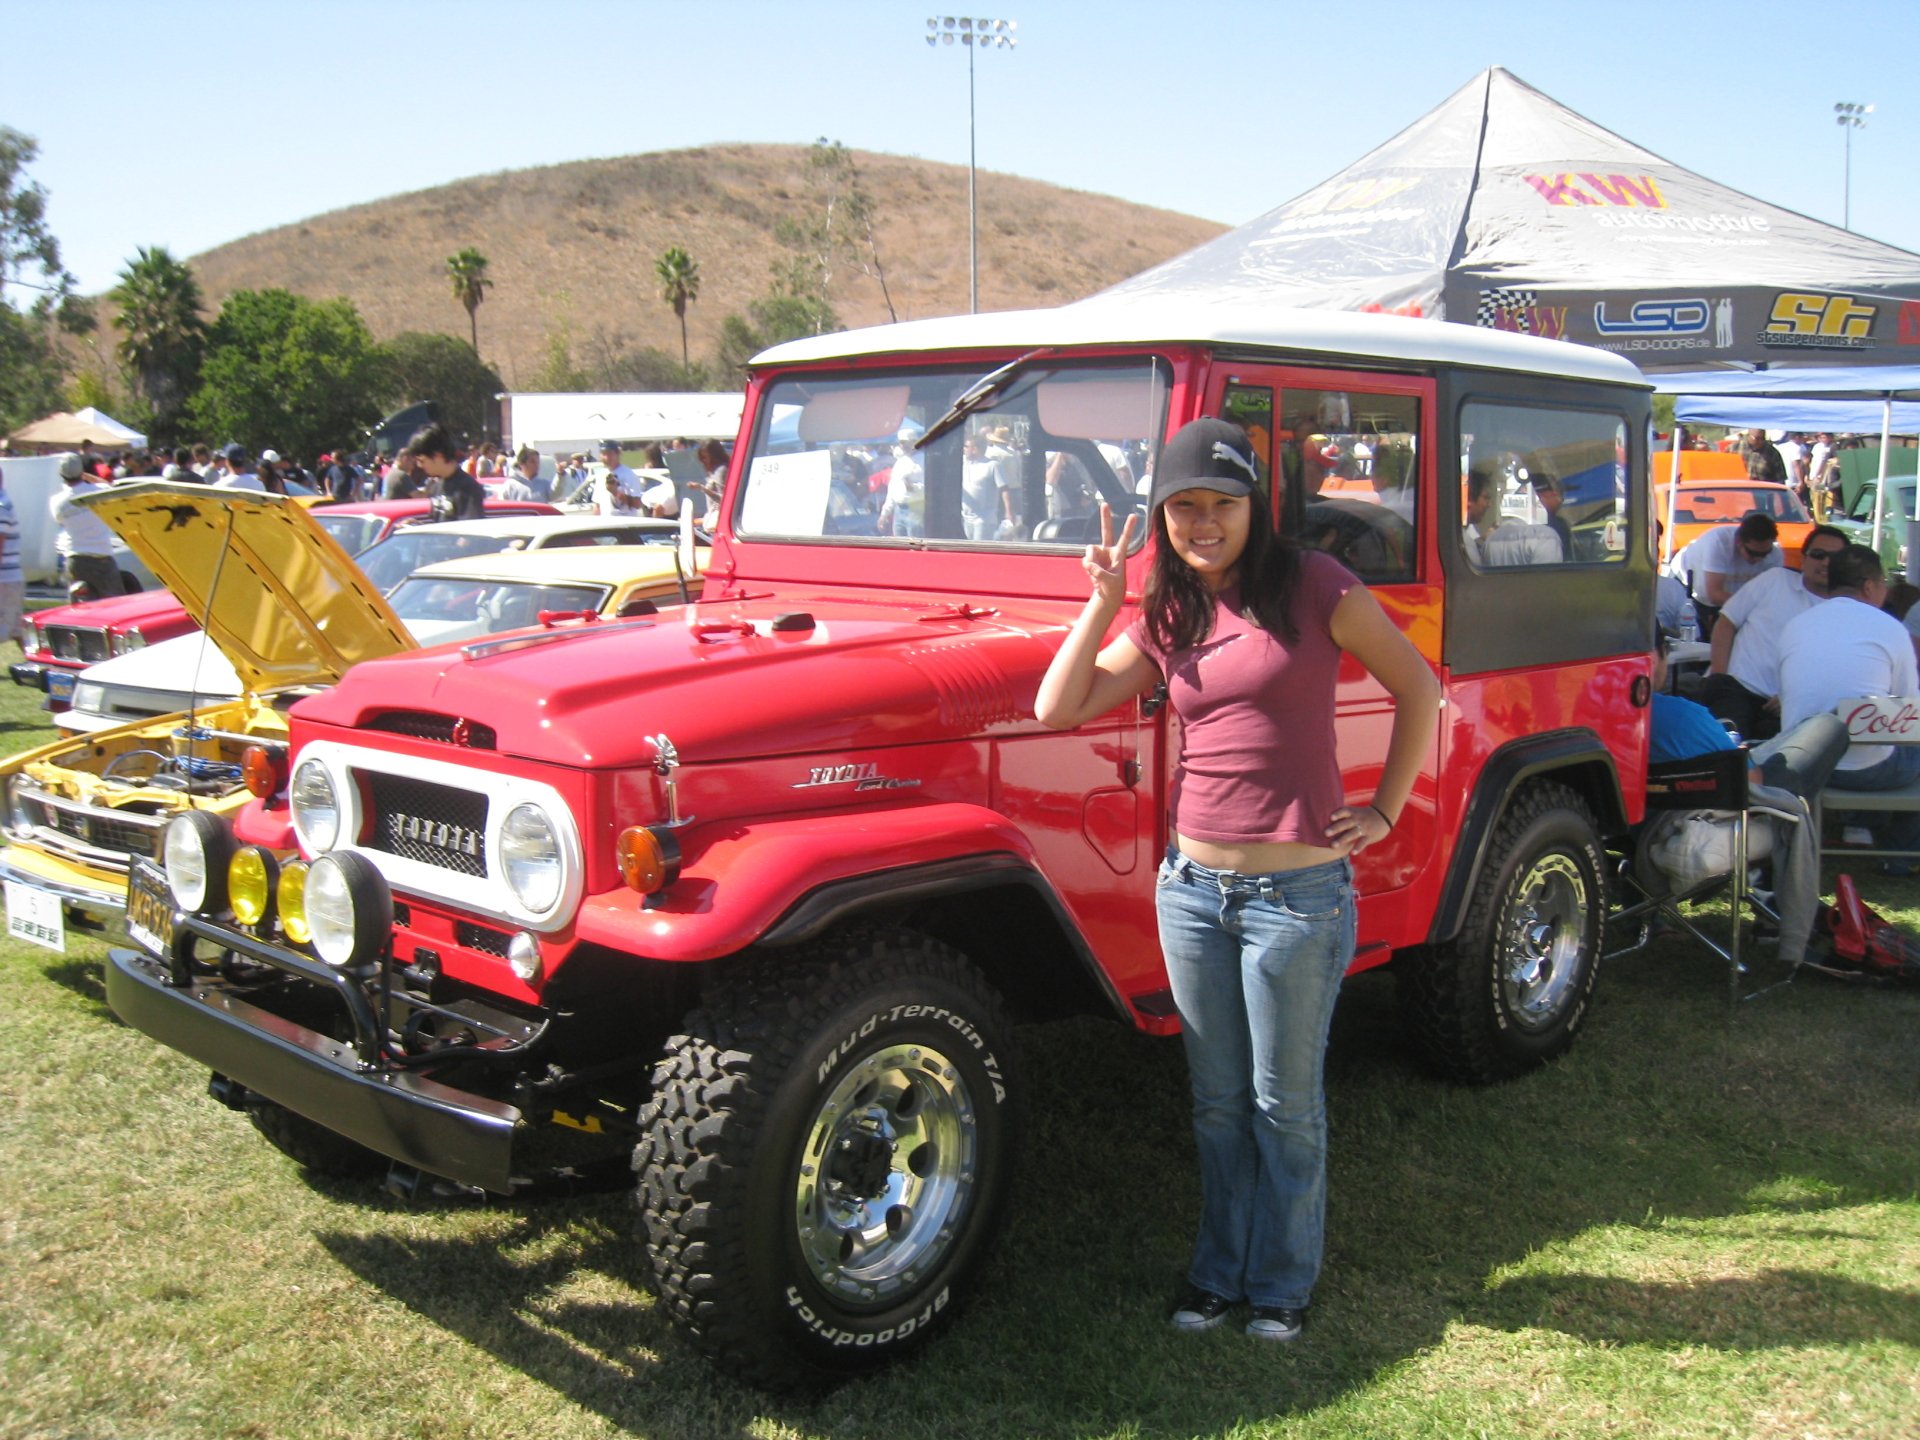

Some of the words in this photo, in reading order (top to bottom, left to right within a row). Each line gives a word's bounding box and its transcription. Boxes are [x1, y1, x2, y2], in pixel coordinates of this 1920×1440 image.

[1522, 173, 1669, 208] KW
[1592, 211, 1771, 232] automotive
[1494, 306, 1568, 340] KW
[1594, 299, 1710, 336] LSD
[1845, 703, 1919, 736] Colt
[809, 762, 878, 785] TOYOTA
[396, 812, 478, 856] TOYOTA
[818, 1004, 984, 1084] Mud-Terrain
[983, 1051, 1006, 1105] T/A
[786, 1285, 949, 1346] BFGoodrich
